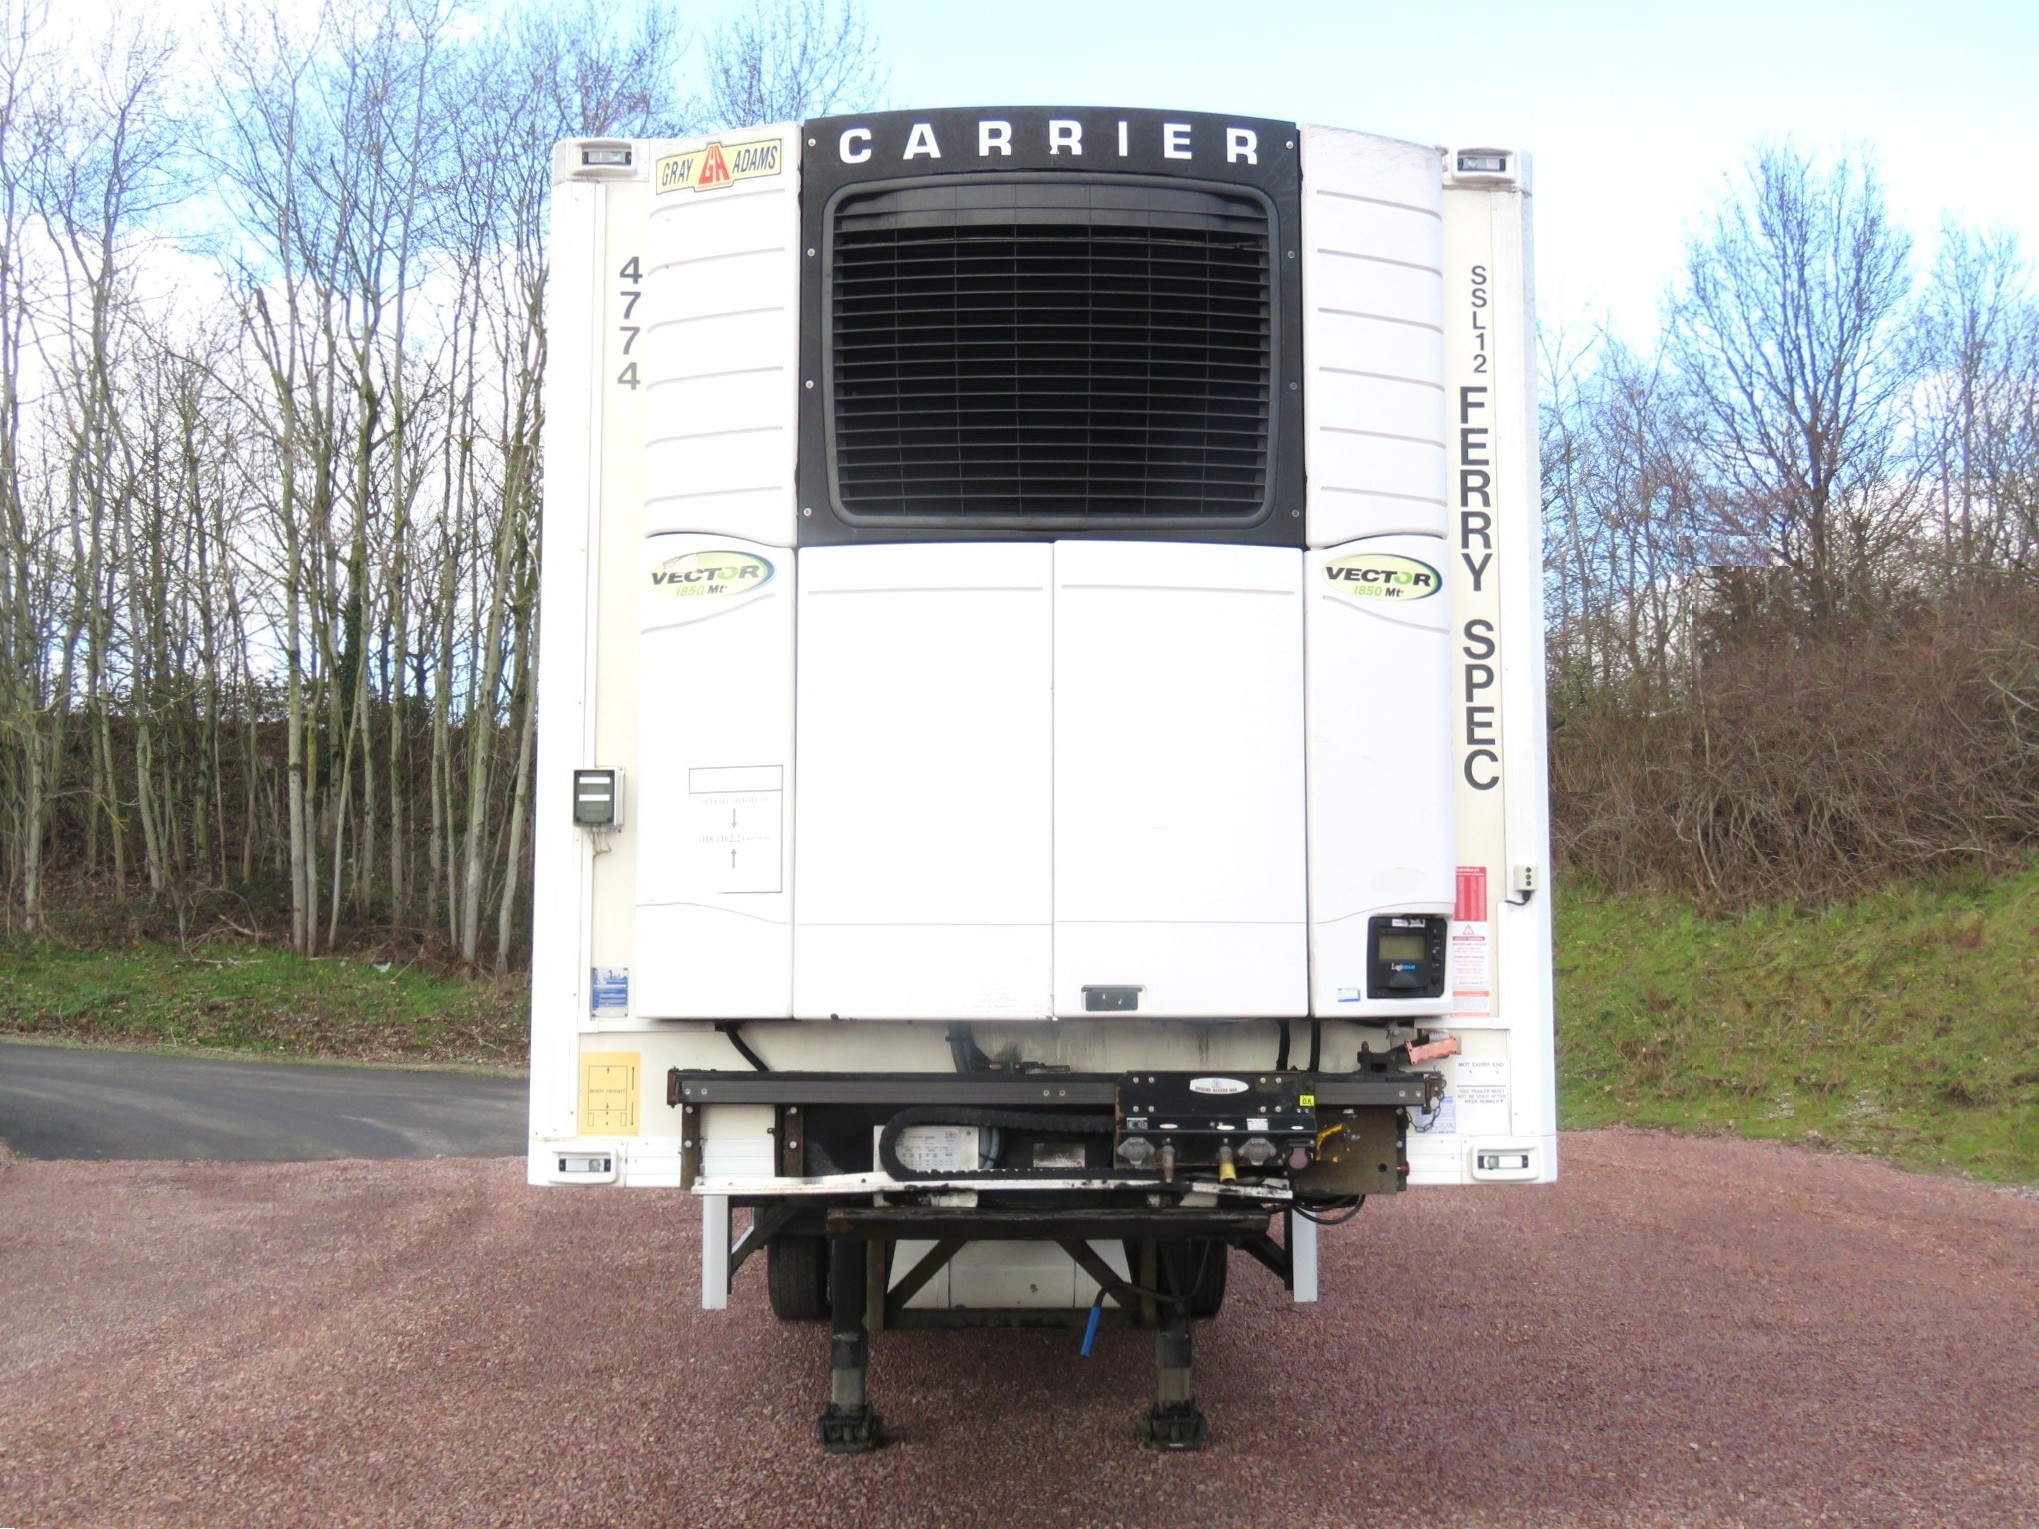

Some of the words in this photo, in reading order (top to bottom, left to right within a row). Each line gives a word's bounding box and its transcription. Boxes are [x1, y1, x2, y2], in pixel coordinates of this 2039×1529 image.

[839, 119, 1258, 165] CARRIER
[661, 157, 694, 187] GRAY
[732, 145, 778, 174] ADAMS
[617, 256, 643, 391] 4774
[1471, 265, 1488, 373] SSL12
[1460, 386, 1493, 592] FERRY
[651, 564, 760, 585] VECTOR
[676, 585, 704, 597] 1850
[1326, 566, 1431, 587] VECTOR
[1354, 585, 1382, 597] 1850
[1463, 618, 1500, 791] SPEC
